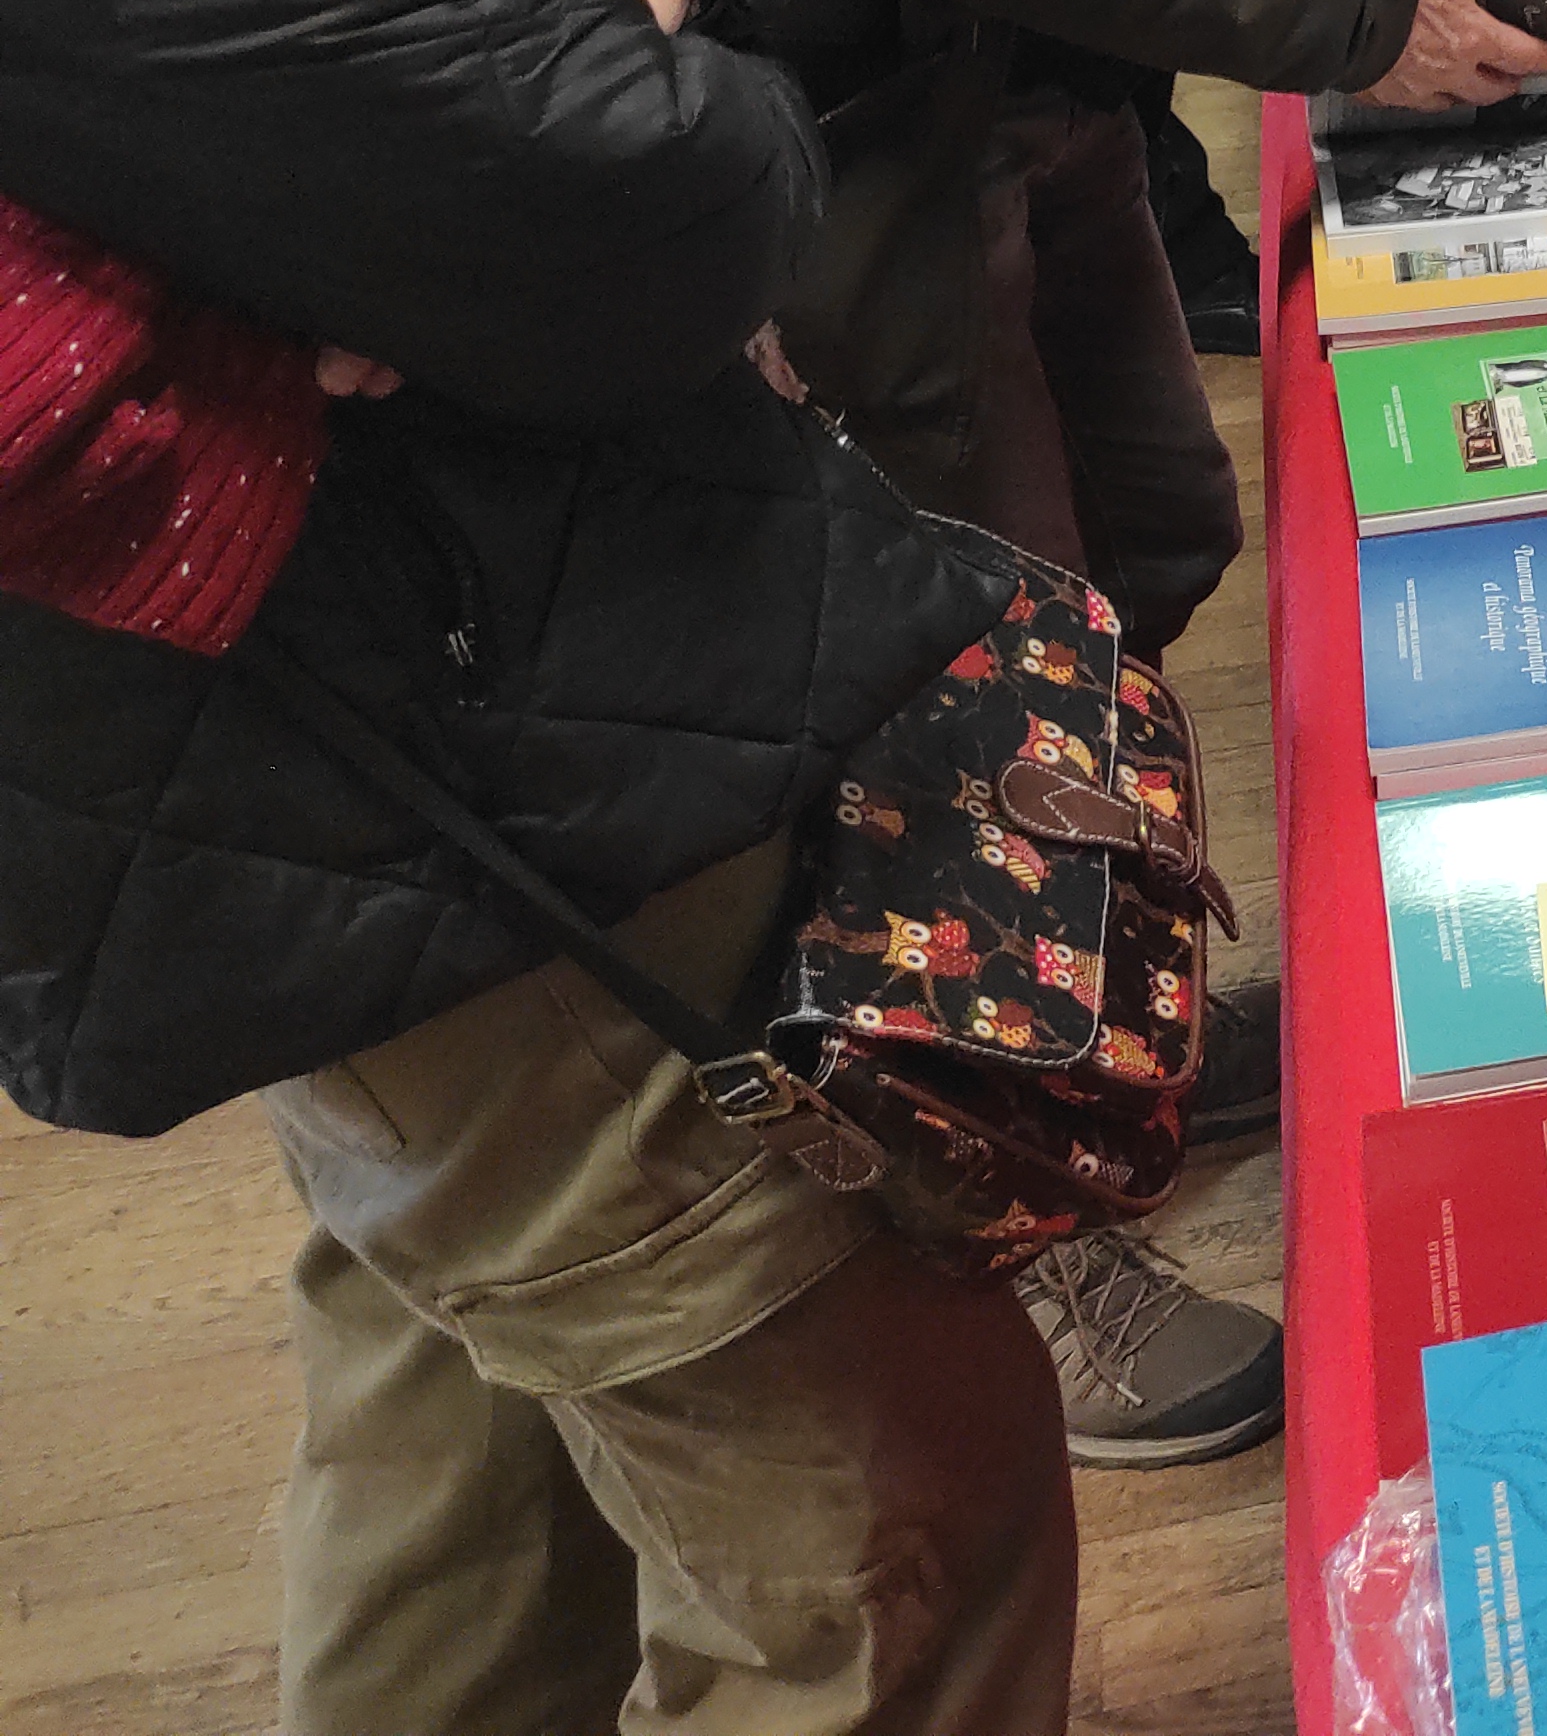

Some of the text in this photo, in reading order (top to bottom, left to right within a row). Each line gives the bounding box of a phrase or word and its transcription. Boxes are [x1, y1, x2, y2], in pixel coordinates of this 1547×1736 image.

[1513, 543, 1538, 604] Panorama
[1479, 581, 1511, 653] et historique
